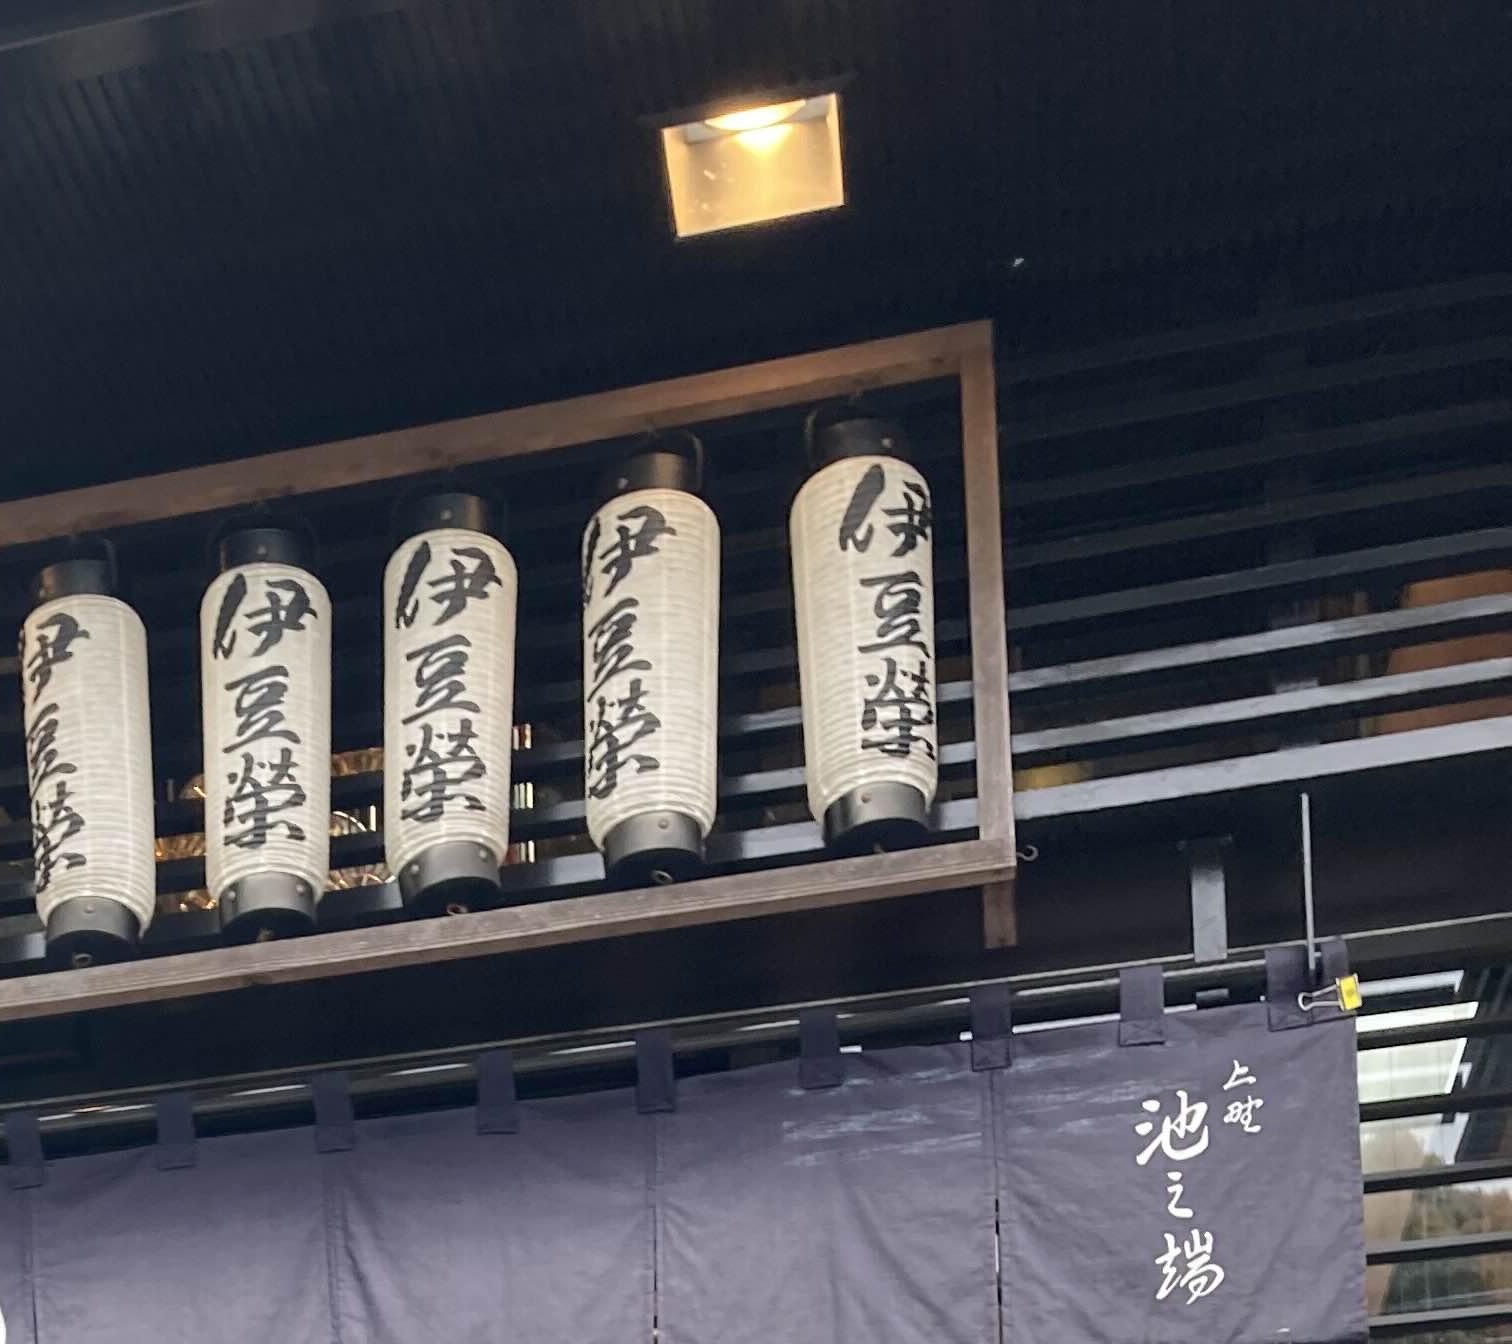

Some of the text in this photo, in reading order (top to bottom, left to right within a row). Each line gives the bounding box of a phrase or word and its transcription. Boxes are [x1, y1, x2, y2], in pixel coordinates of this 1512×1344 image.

[213, 573, 318, 849] 伊豆榮
[395, 540, 503, 823] 伊豆榮
[582, 504, 677, 800] 伊豆榮
[838, 464, 934, 760] 伊豆榮
